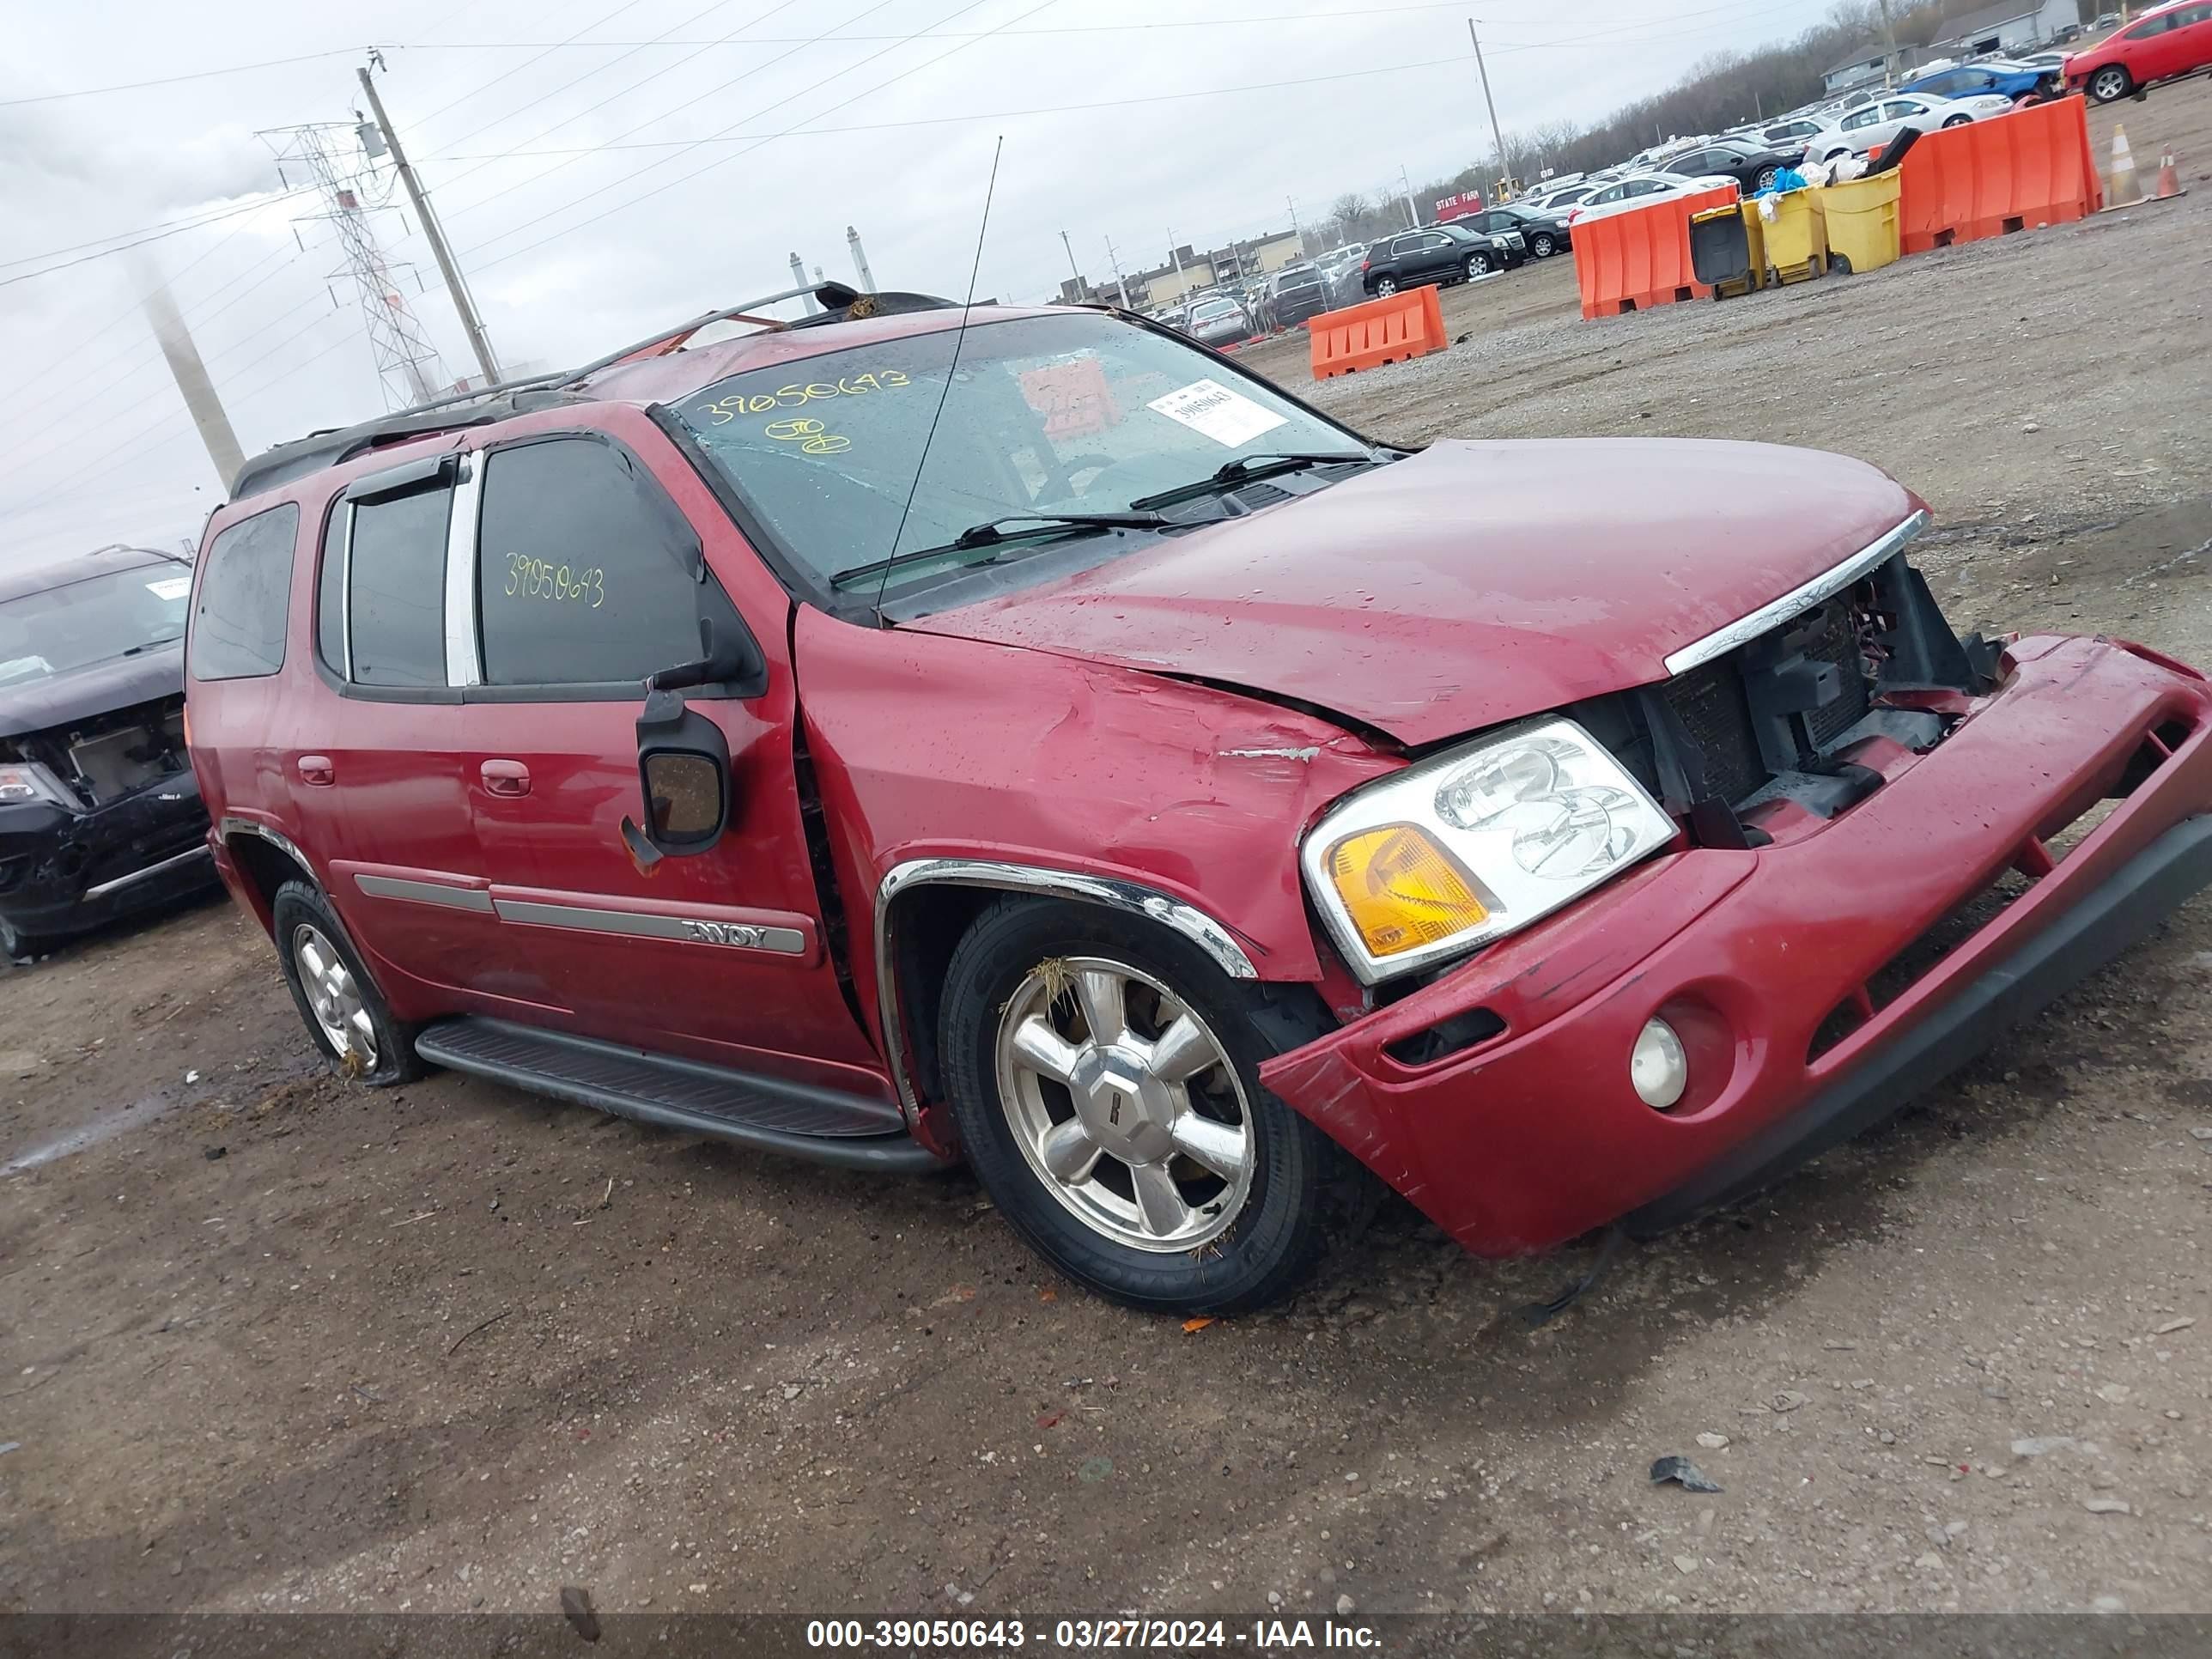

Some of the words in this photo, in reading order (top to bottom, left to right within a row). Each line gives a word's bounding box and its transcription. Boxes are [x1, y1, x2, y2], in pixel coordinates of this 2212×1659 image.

[1436, 196, 1458, 210] STATE
[1462, 190, 1480, 203] FARM
[696, 369, 911, 425] 39050643
[1174, 391, 1232, 419] 39050643
[505, 552, 605, 608] 39050643
[681, 920, 767, 948] ENVOY
